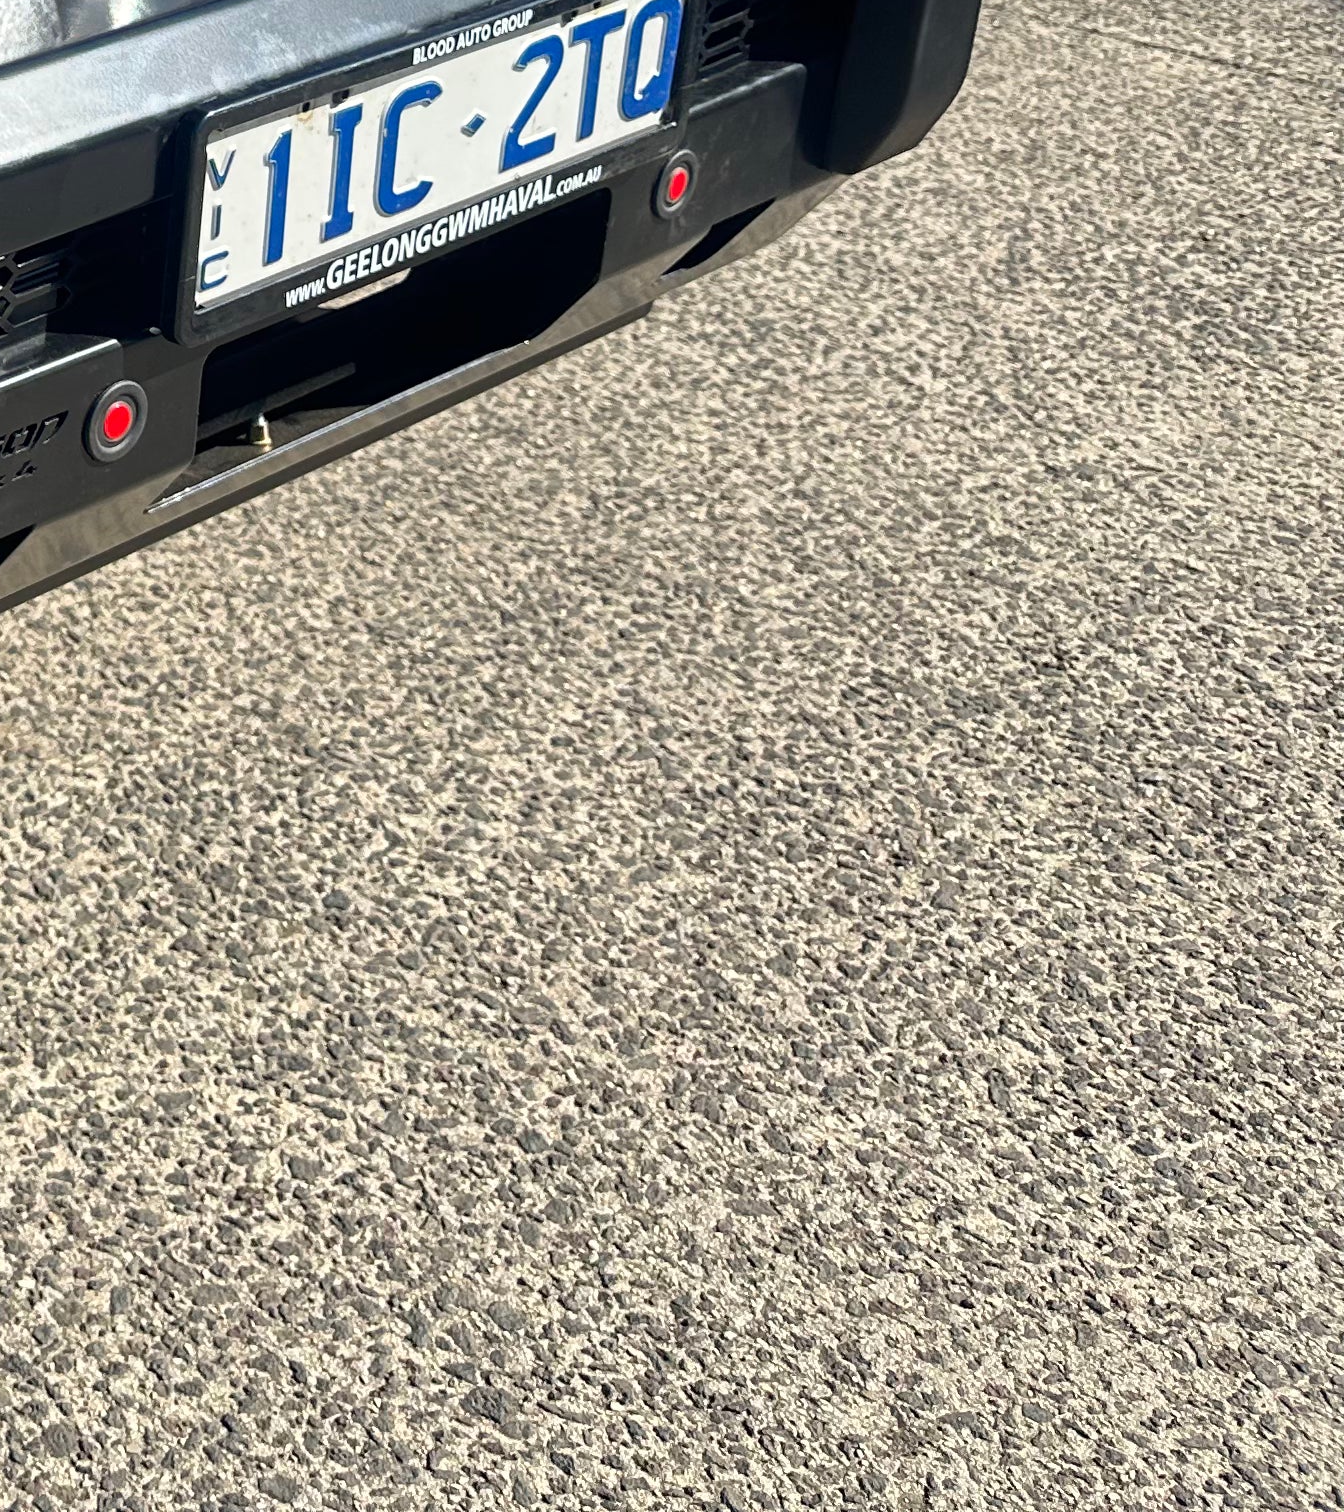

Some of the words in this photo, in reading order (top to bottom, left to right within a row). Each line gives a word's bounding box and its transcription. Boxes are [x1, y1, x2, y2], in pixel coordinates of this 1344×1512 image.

[412, 36, 454, 66] BLOOD
[455, 22, 491, 50] AUTO
[493, 8, 534, 39] GROUP
